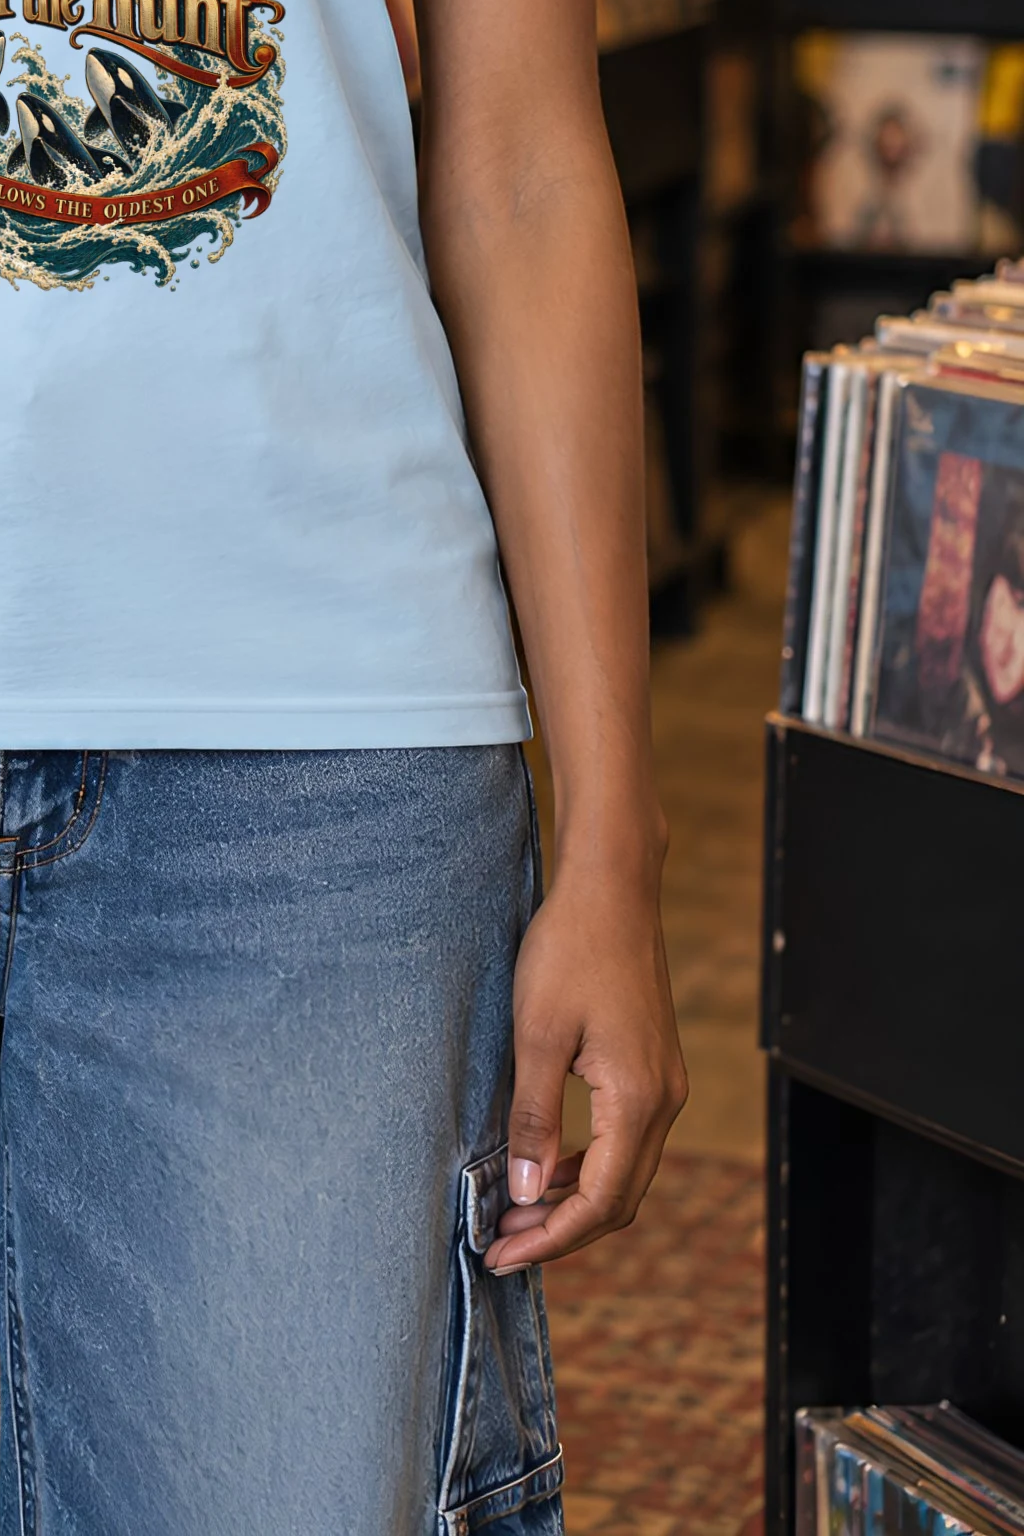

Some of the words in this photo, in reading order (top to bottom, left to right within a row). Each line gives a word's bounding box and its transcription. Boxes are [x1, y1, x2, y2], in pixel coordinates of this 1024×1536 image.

[55, 198, 93, 219] THE
[103, 196, 176, 220] OLDEST
[182, 177, 221, 207] ONE
